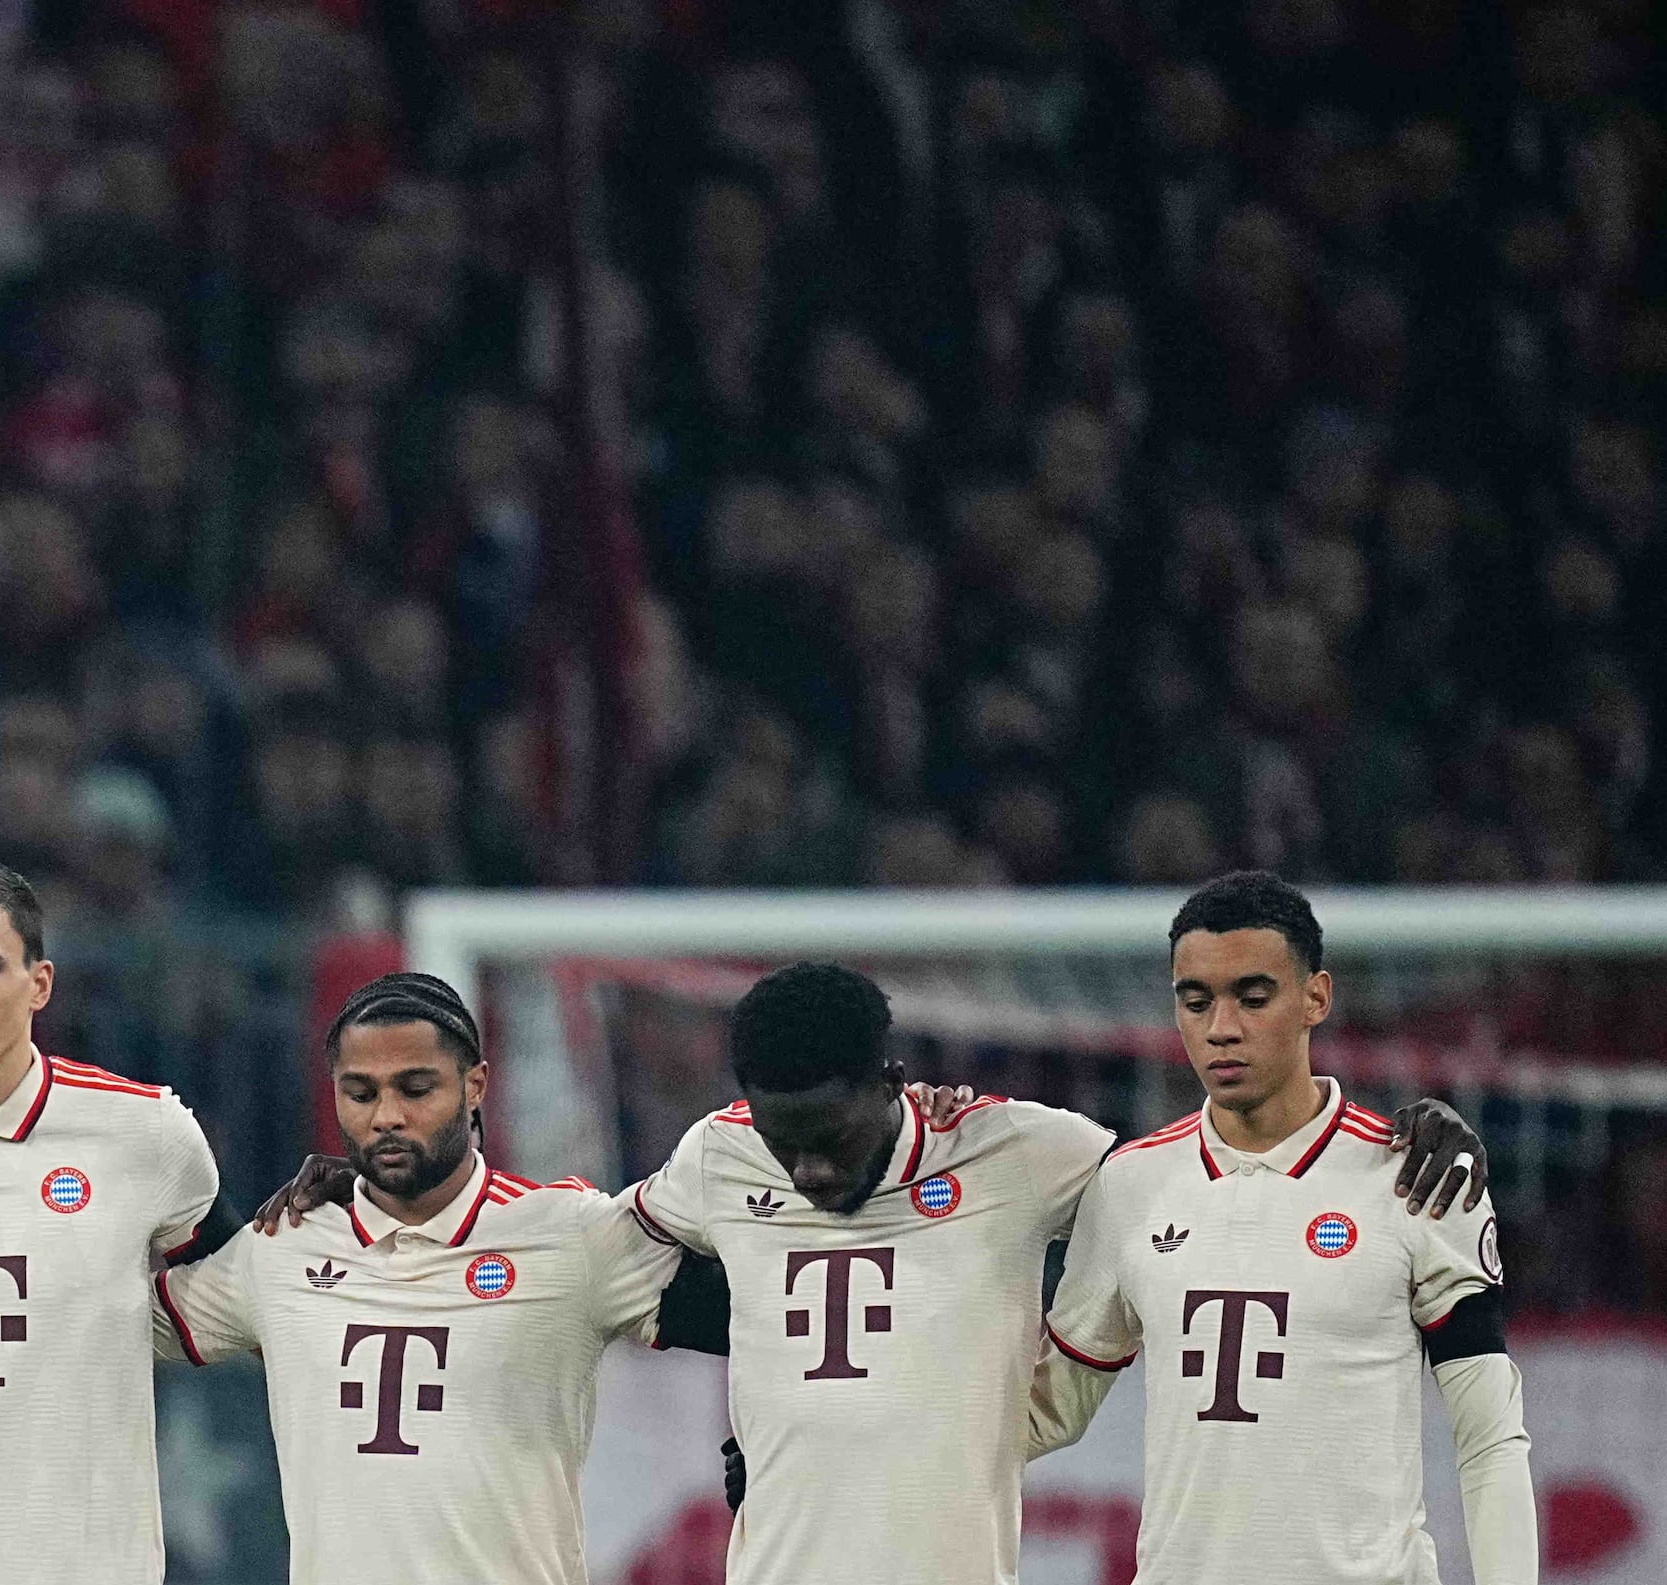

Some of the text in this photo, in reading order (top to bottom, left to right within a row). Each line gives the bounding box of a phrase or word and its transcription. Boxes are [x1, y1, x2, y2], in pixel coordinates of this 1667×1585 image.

[785, 1247, 894, 1380] T
[1183, 1290, 1289, 1423] T
[340, 1324, 450, 1455] T
